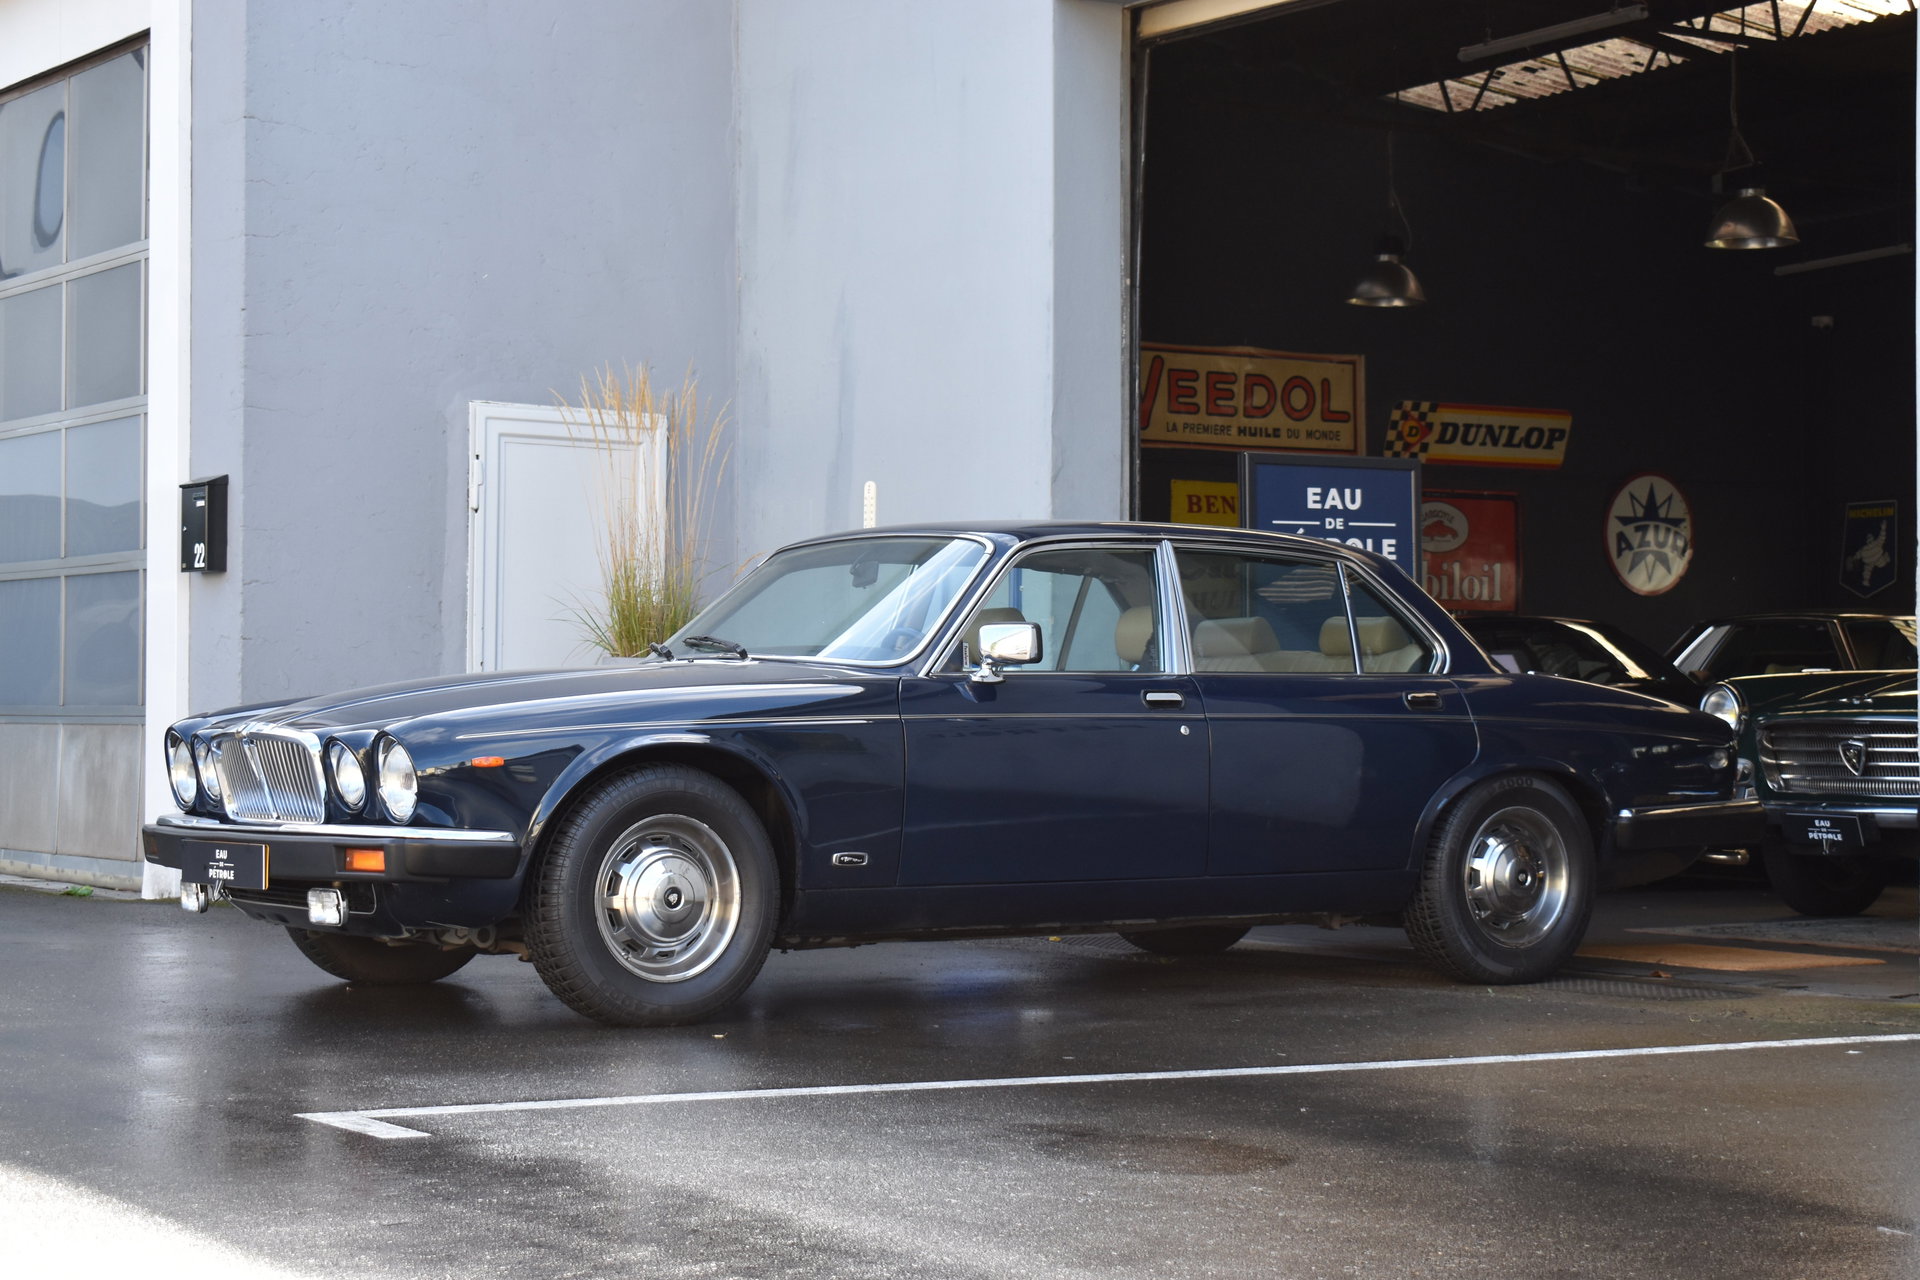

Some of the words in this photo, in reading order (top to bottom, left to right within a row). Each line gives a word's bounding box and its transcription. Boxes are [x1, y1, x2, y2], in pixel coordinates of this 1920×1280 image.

[1166, 421, 1178, 433] LA
[1237, 425, 1281, 438] HUILE
[1287, 428, 1300, 439] DU
[1306, 429, 1341, 441] MONDE
[1407, 425, 1420, 438] D
[1435, 422, 1566, 450] DUNLOP
[1307, 488, 1362, 510] EAU
[1325, 518, 1344, 530] DE
[1616, 524, 1688, 560] AZUR
[194, 542, 205, 568] 22
[1421, 559, 1501, 601] biloil
[1814, 819, 1831, 827] EAU
[215, 849, 228, 859] EAU
